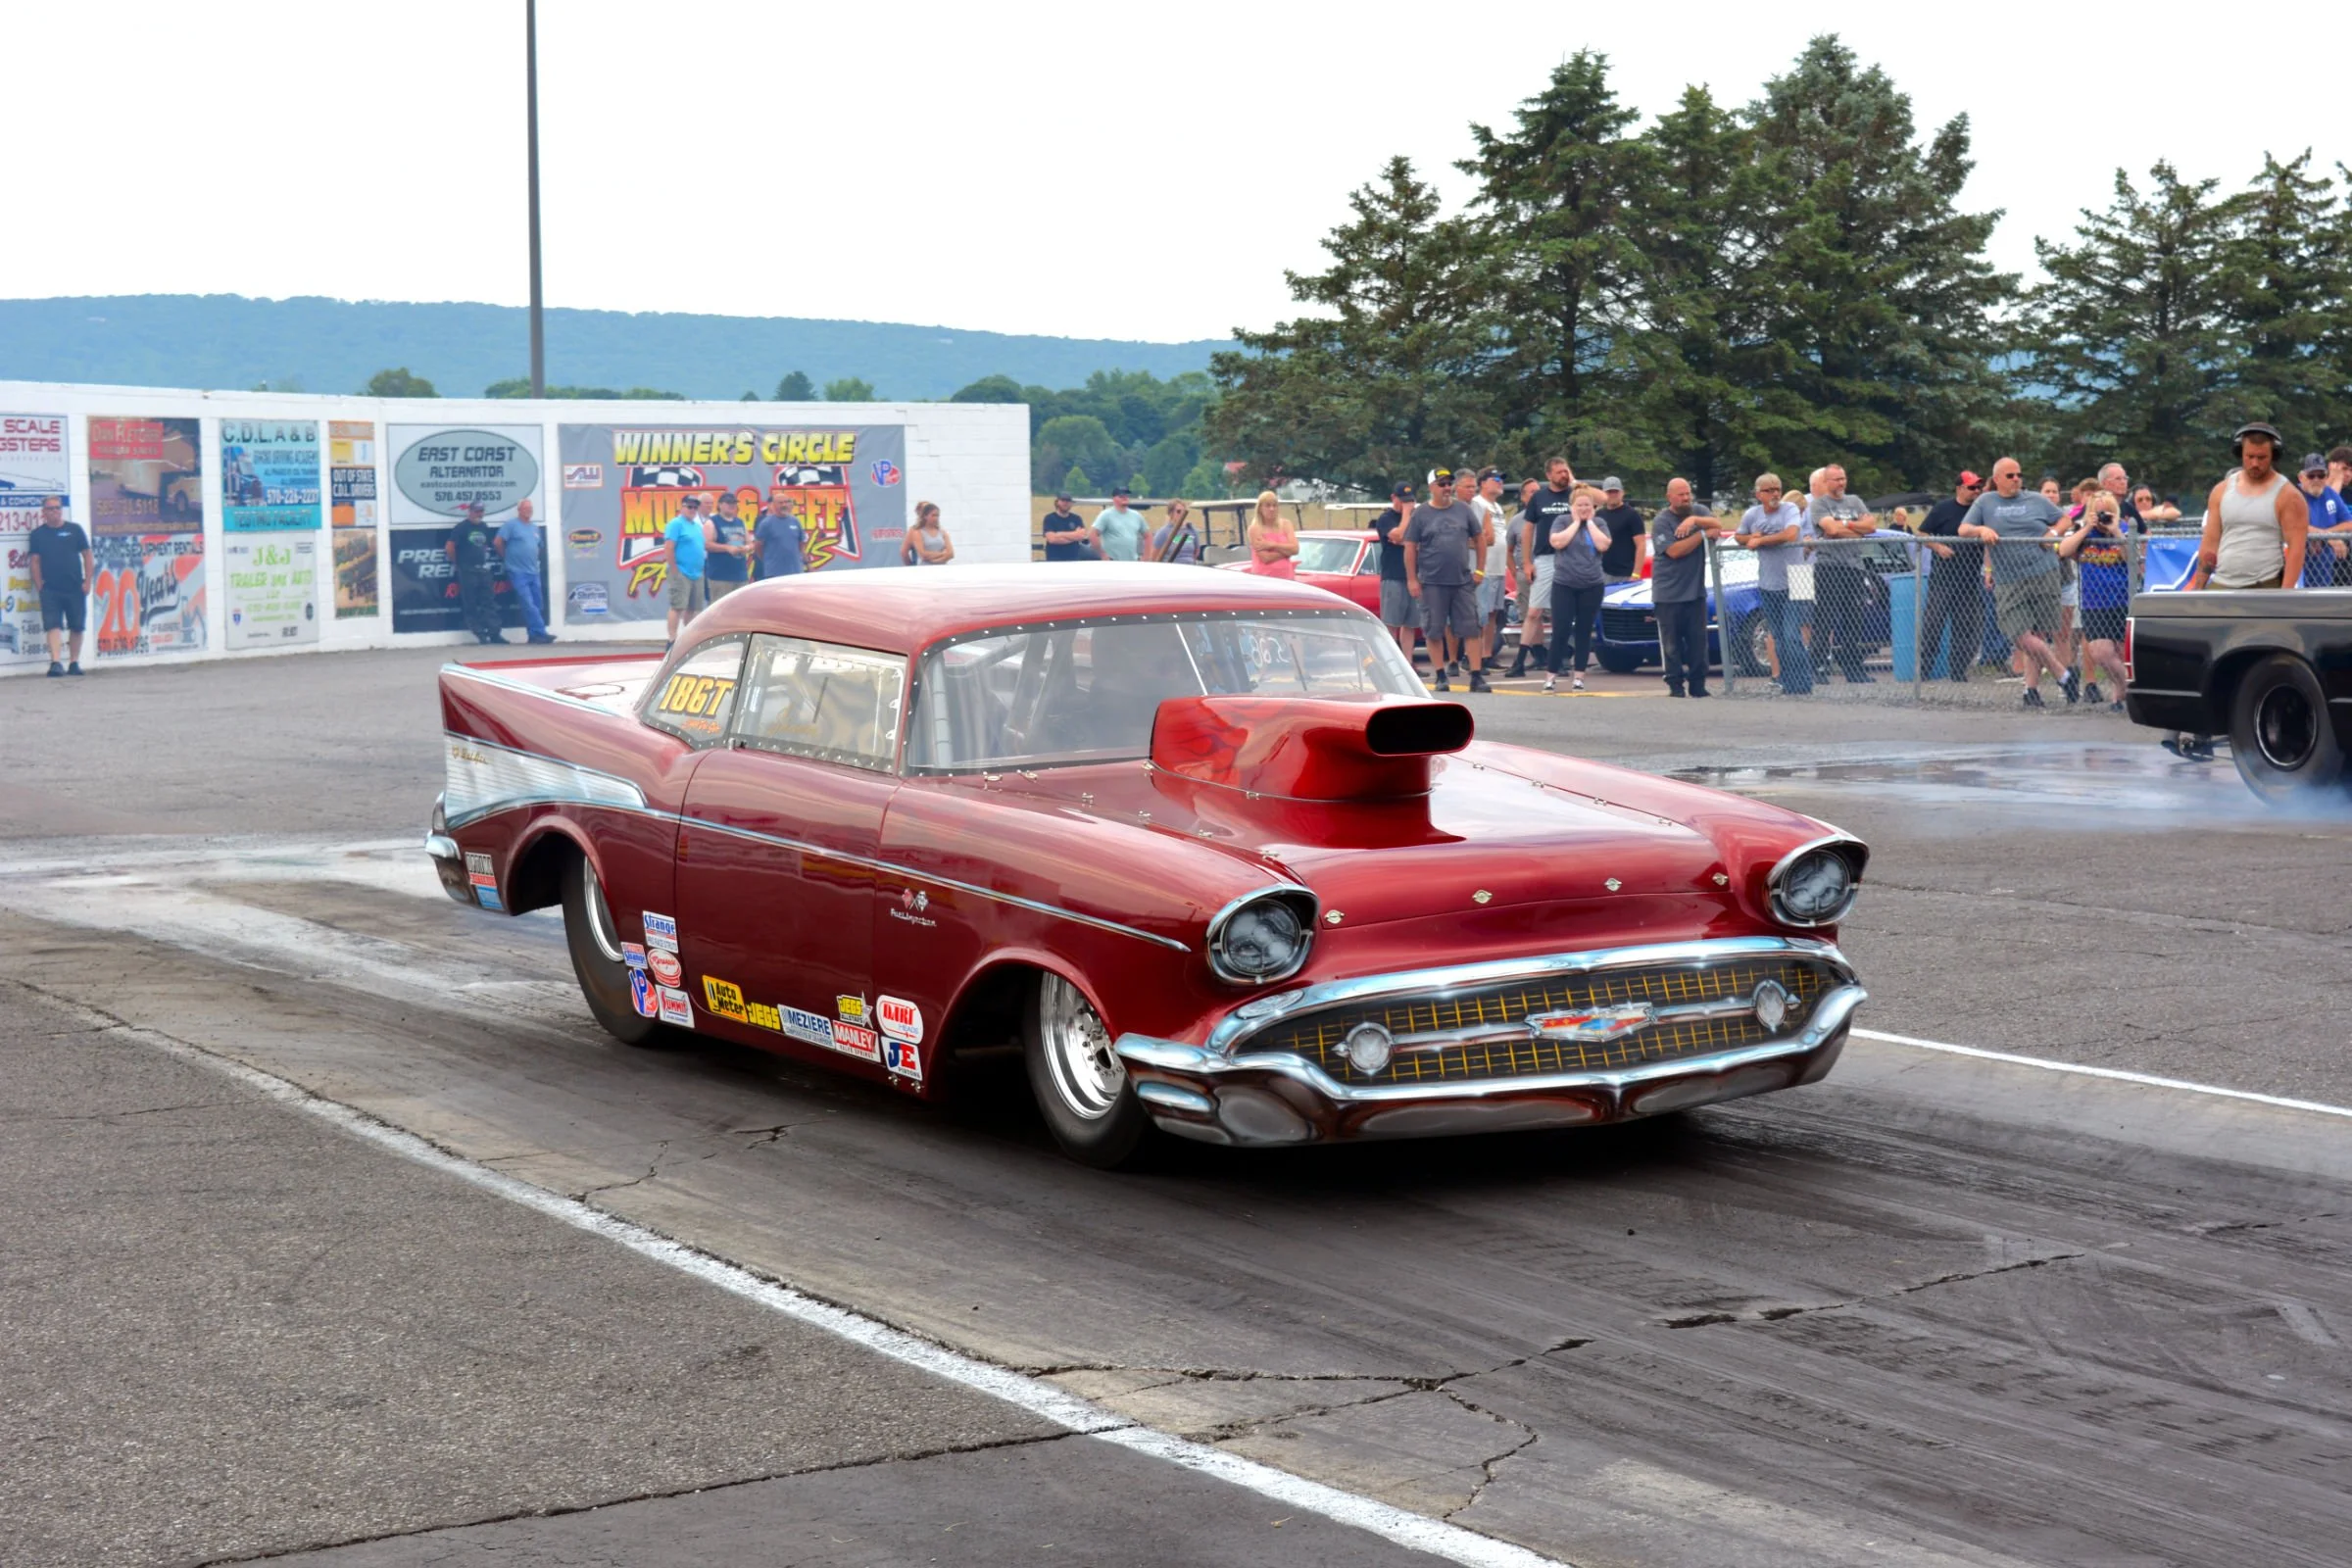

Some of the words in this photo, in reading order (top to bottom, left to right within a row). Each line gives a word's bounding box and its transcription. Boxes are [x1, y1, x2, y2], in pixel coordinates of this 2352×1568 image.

[4, 418, 61, 434] SCALE
[274, 426, 286, 442] A
[290, 425, 301, 442] &
[306, 426, 316, 442] B
[417, 447, 460, 462] EAST
[464, 447, 516, 462] COAST
[614, 431, 755, 466] WINNER'S
[760, 431, 857, 466] CIRCLE
[429, 466, 504, 478] ALTERNATOR
[419, 479, 516, 489] eastcoastalternator.com
[96, 568, 141, 653] 20
[656, 674, 737, 718] 186T
[645, 915, 674, 934] Strange
[716, 982, 737, 1001] Auto
[718, 996, 744, 1015] Meter
[839, 996, 862, 1016] JEGS
[883, 1003, 916, 1025] DART
[748, 1003, 782, 1031] JEGS
[788, 1009, 831, 1036] MEZIERE
[834, 1024, 874, 1053] MANLEY
[888, 1042, 916, 1070] JE
